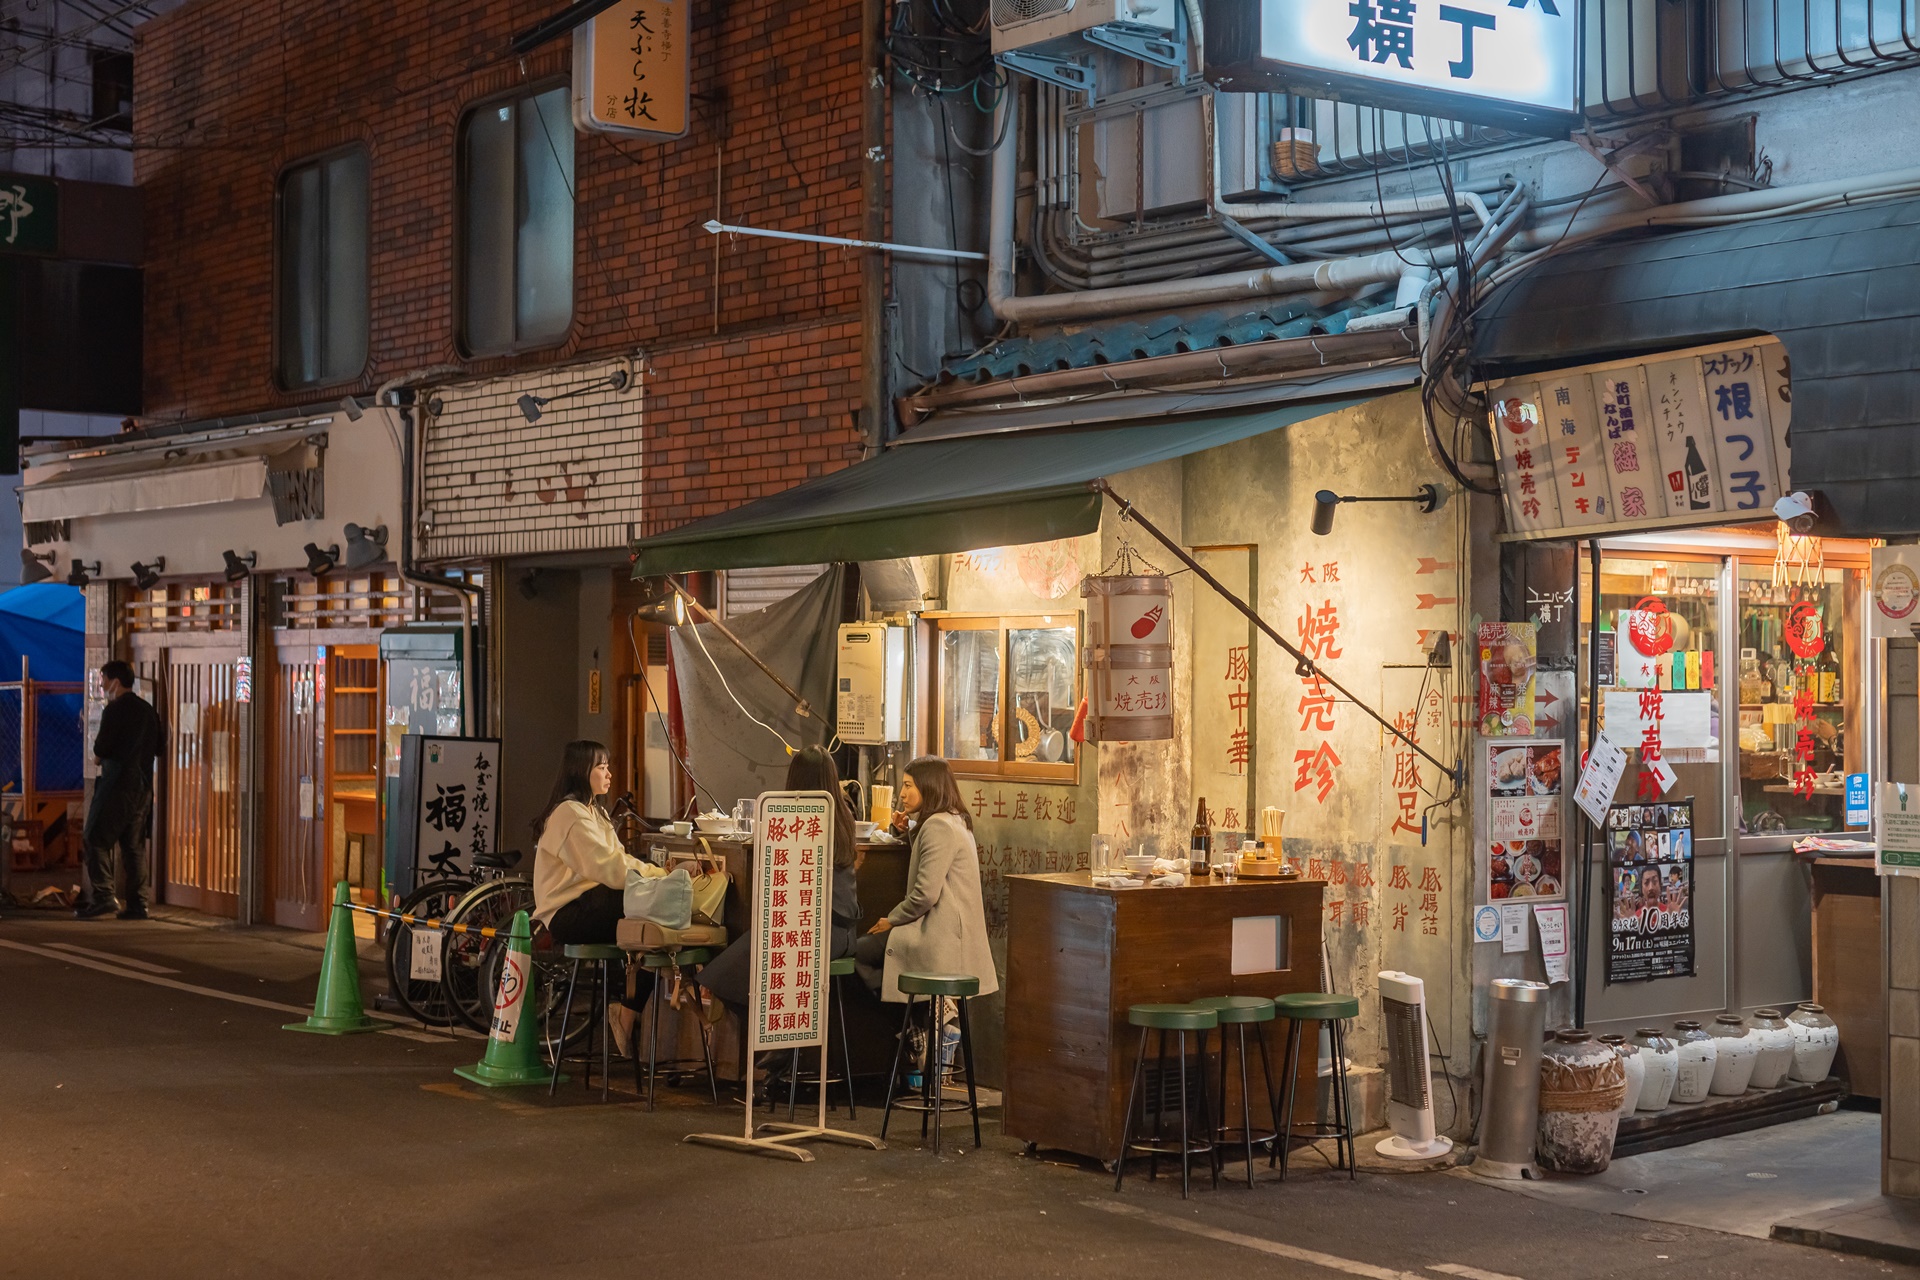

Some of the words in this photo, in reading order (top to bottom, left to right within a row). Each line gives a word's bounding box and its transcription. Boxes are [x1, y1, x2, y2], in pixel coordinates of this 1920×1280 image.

[1346, 0, 1496, 79] 横丁
[623, 10, 658, 121] 天ぷら牧
[606, 95, 618, 119] 分店
[1704, 352, 1754, 376] スナック
[1555, 385, 1577, 436] 南海
[1604, 403, 1622, 440] なんば
[1714, 382, 1765, 510] 根つ子
[1514, 447, 1541, 520] 焼売珍
[1299, 560, 1341, 584] 大阪
[1526, 586, 1574, 603] ユニバース
[1539, 604, 1564, 623] 横丁
[1127, 674, 1161, 687] 大阪
[1640, 662, 1664, 677] 大阪
[1113, 690, 1168, 712] 焼売珍
[1224, 645, 1253, 774] 豚中華
[1293, 598, 1343, 805] 焼売珍
[1637, 683, 1666, 802] 焼売珍
[1793, 687, 1819, 801] 焼売珍
[1390, 708, 1423, 837] 焼豚足
[971, 788, 1077, 825] 手土産歓迎
[767, 815, 824, 843] 豚中華
[773, 849, 814, 867] 豚足
[772, 869, 814, 887] 豚耳
[772, 889, 814, 907] 豚胃
[1327, 859, 1348, 928] 豚耳
[1352, 861, 1376, 928] 豚頭
[1388, 865, 1412, 932] 豚背
[1418, 866, 1443, 936] 豚腸詰
[771, 910, 813, 928] 豚舌
[771, 930, 813, 949] 豚喉笛
[770, 951, 813, 969] 豚肝
[769, 972, 812, 990] 豚助
[769, 991, 811, 1010] 豚背
[767, 1012, 810, 1031] 豚頭肉
